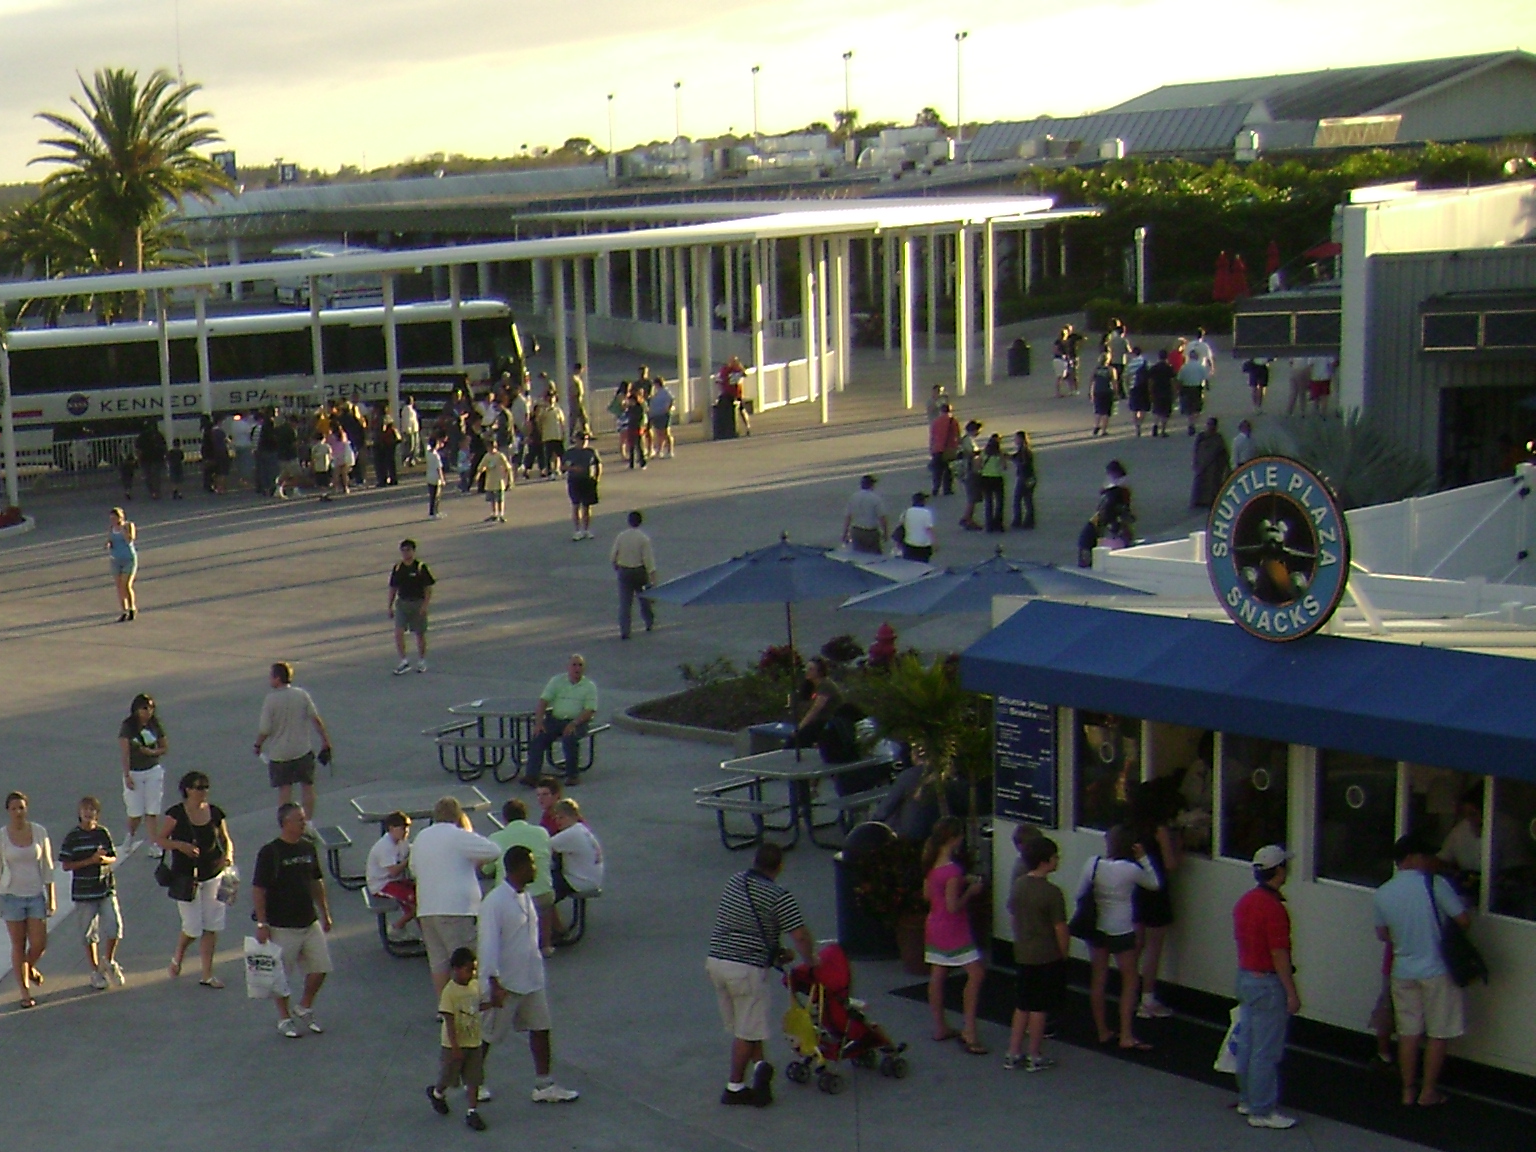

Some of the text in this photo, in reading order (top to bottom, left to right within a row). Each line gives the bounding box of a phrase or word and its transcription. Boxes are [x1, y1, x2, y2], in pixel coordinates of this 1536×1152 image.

[100, 394, 204, 413] KENNED
[1213, 466, 1337, 567] SHUTTLE PLAZA
[1226, 586, 1321, 633] SNACKS
